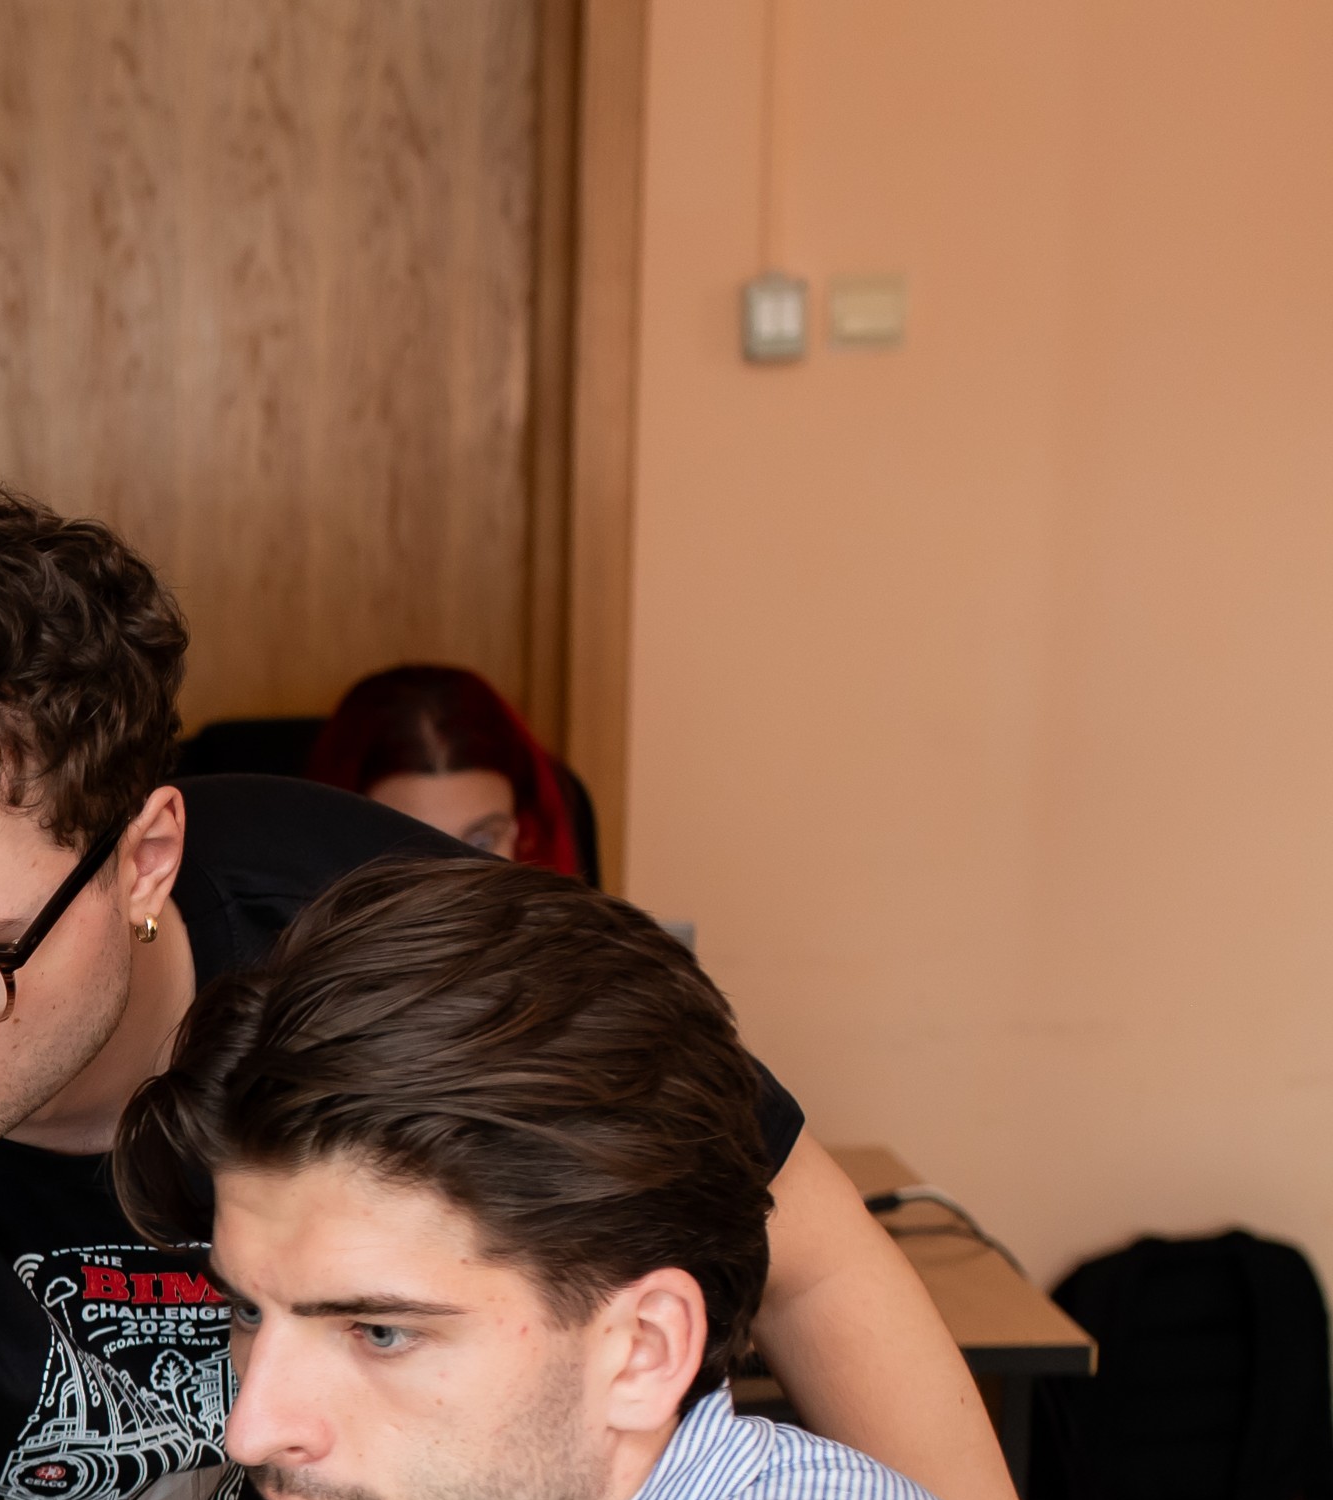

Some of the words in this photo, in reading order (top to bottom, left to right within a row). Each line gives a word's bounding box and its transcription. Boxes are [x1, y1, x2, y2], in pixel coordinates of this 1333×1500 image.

[79, 1252, 122, 1268] THE
[81, 1265, 226, 1304] BIM
[81, 1302, 232, 1322] CHALLENGE
[121, 1320, 196, 1336] 2026
[158, 1336, 177, 1345] DE
[25, 1477, 67, 1488] CELCO
